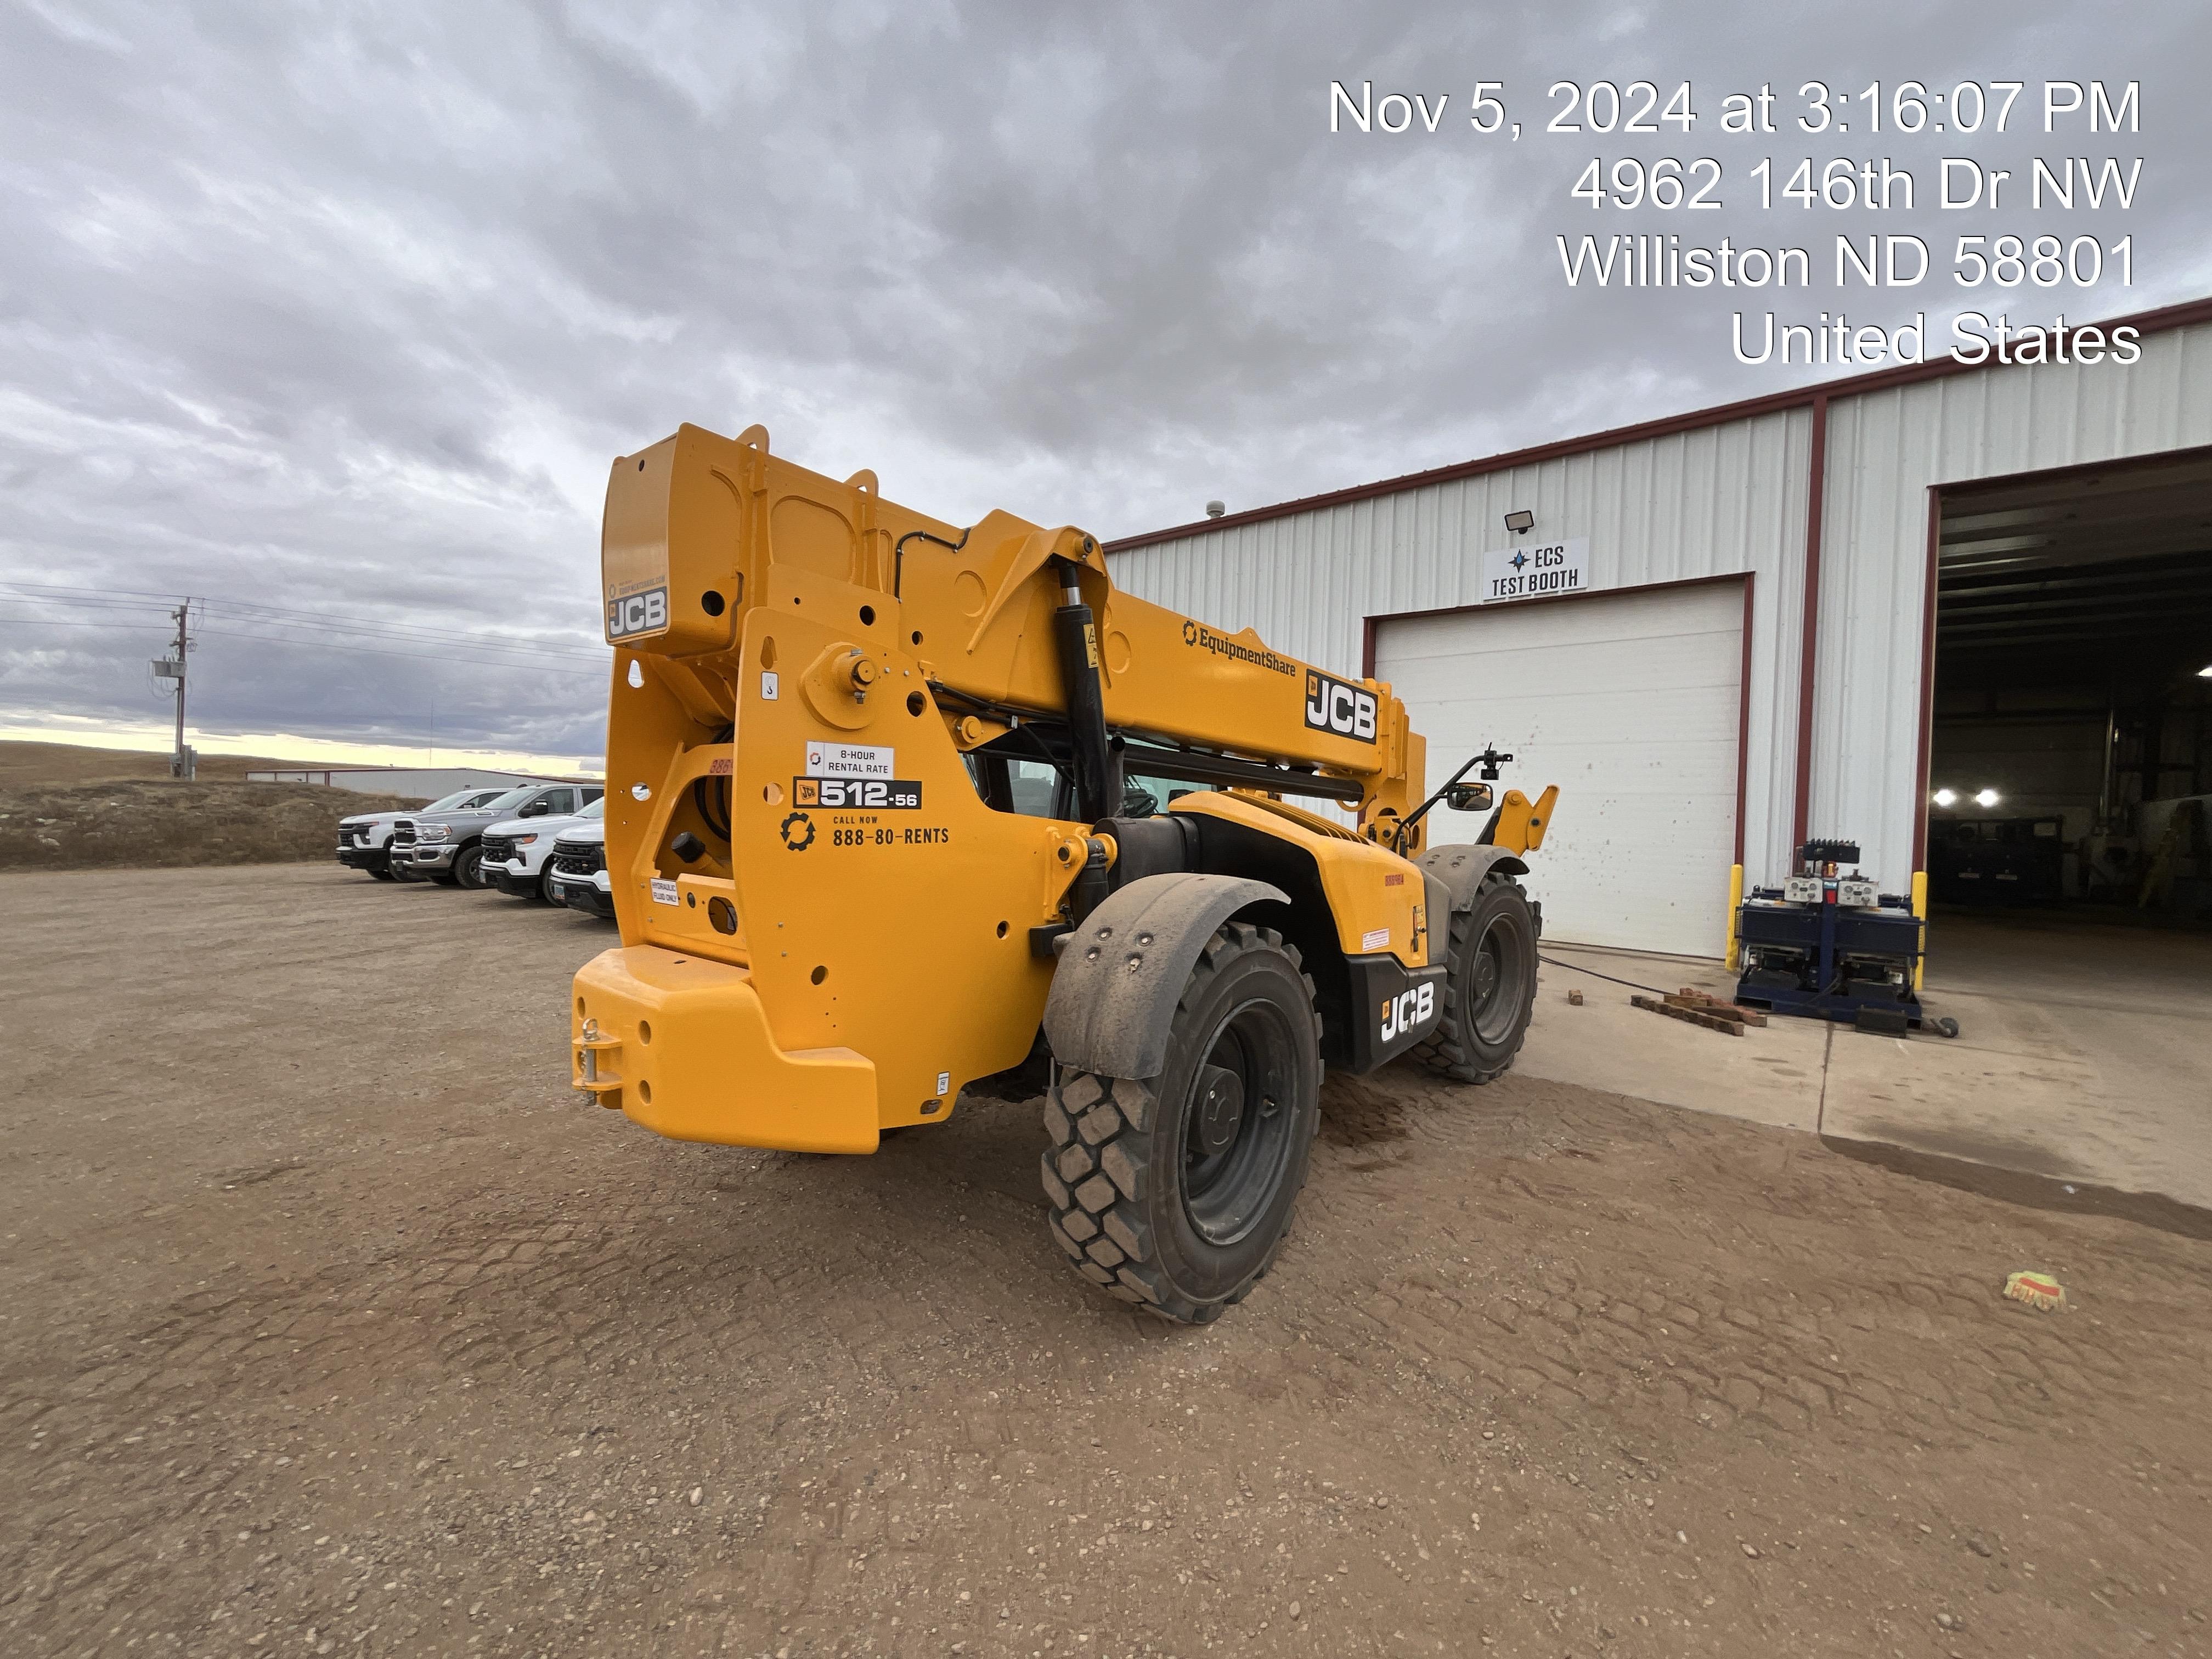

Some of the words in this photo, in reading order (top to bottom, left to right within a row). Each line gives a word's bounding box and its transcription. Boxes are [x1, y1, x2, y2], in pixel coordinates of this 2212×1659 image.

[1535, 545, 1564, 568] ECS
[1492, 575, 1525, 596] TEST
[1528, 568, 1578, 592] BOOTH
[609, 591, 666, 635] JCB
[1199, 627, 1296, 678] EquipmentShare
[1307, 679, 1376, 739] JCB
[840, 750, 876, 760] 8-HOUR
[828, 762, 863, 772] RENTAL
[866, 765, 889, 774] RATE
[803, 785, 816, 797] JCB
[833, 828, 949, 847] 888-80-RENTS
[1381, 981, 1434, 1042] JCB
